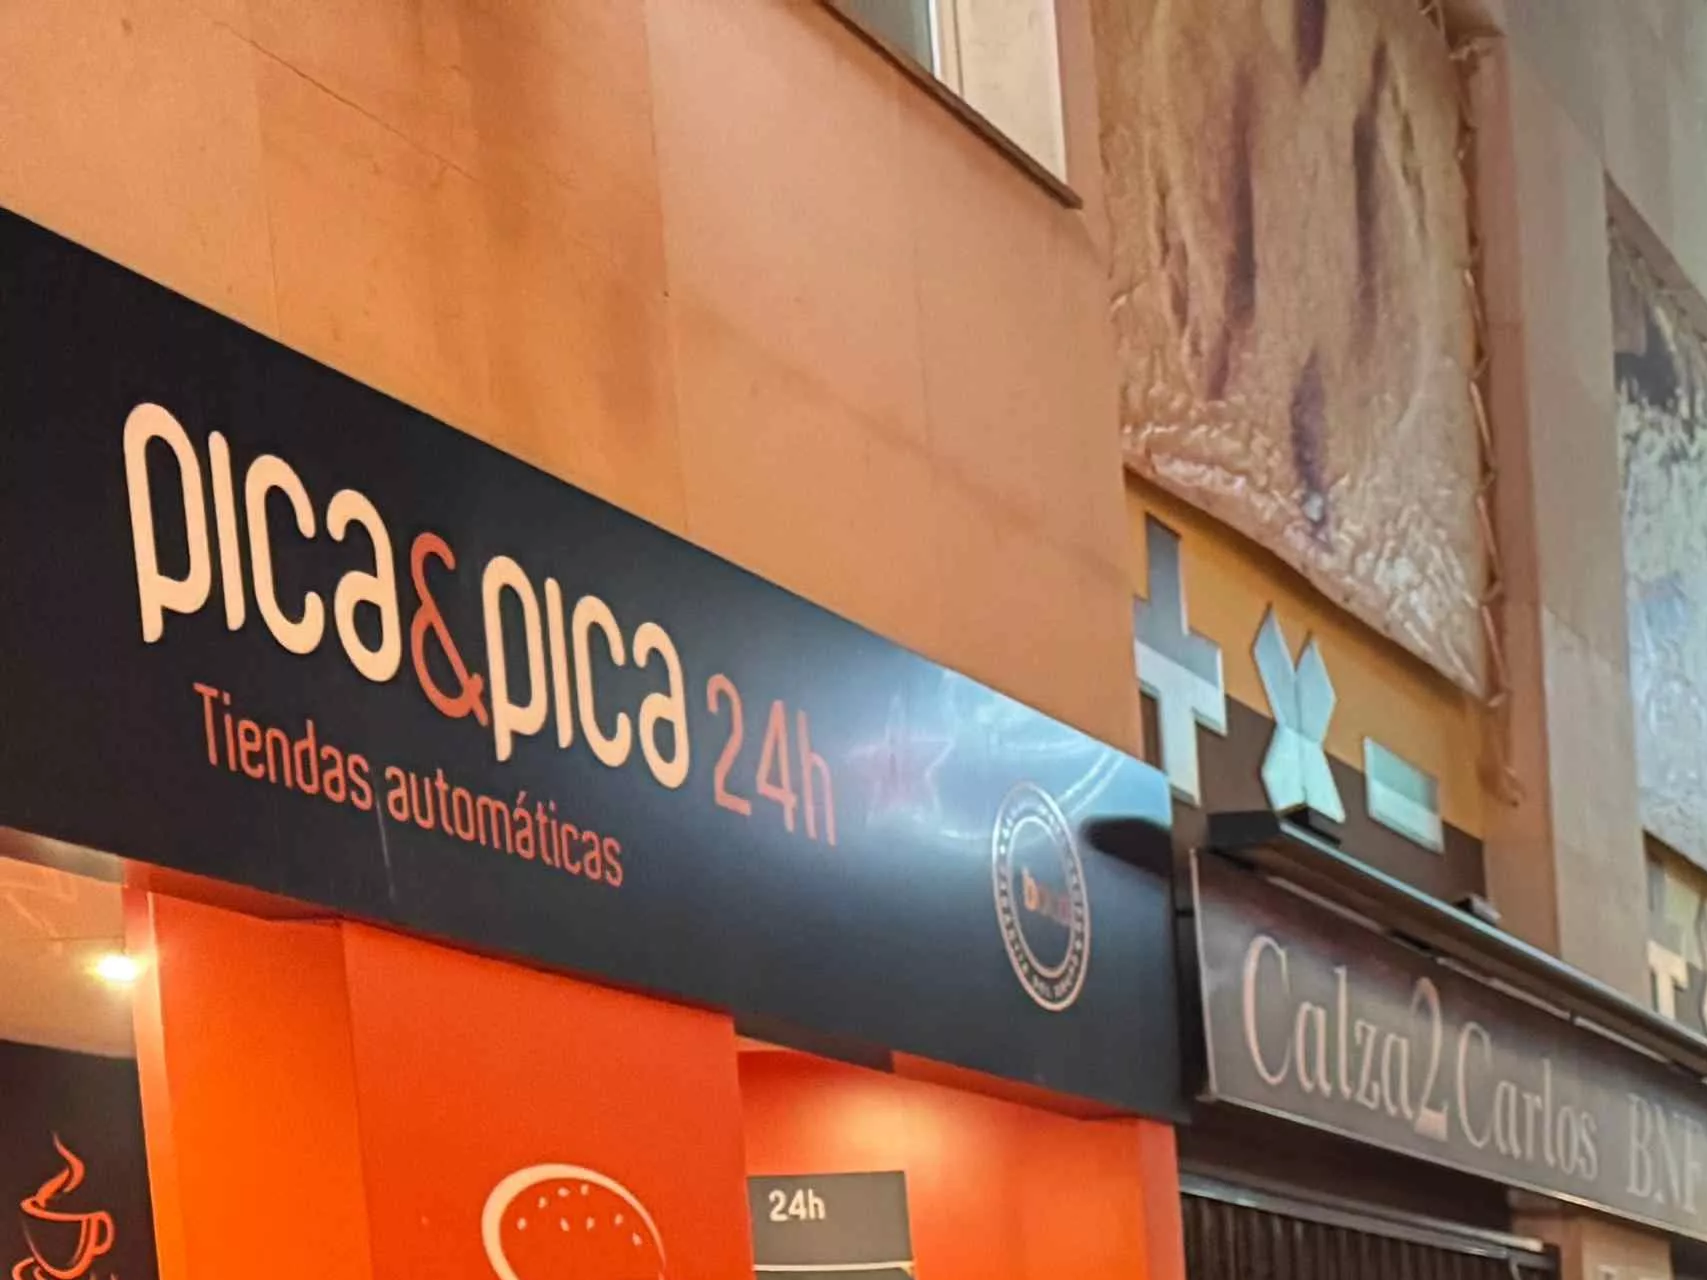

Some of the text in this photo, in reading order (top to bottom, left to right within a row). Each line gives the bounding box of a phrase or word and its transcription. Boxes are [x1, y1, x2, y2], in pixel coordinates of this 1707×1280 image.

[193, 682, 624, 889] Tiendas automáticas
[705, 673, 837, 846] 24h
[769, 1189, 825, 1222] 24h
